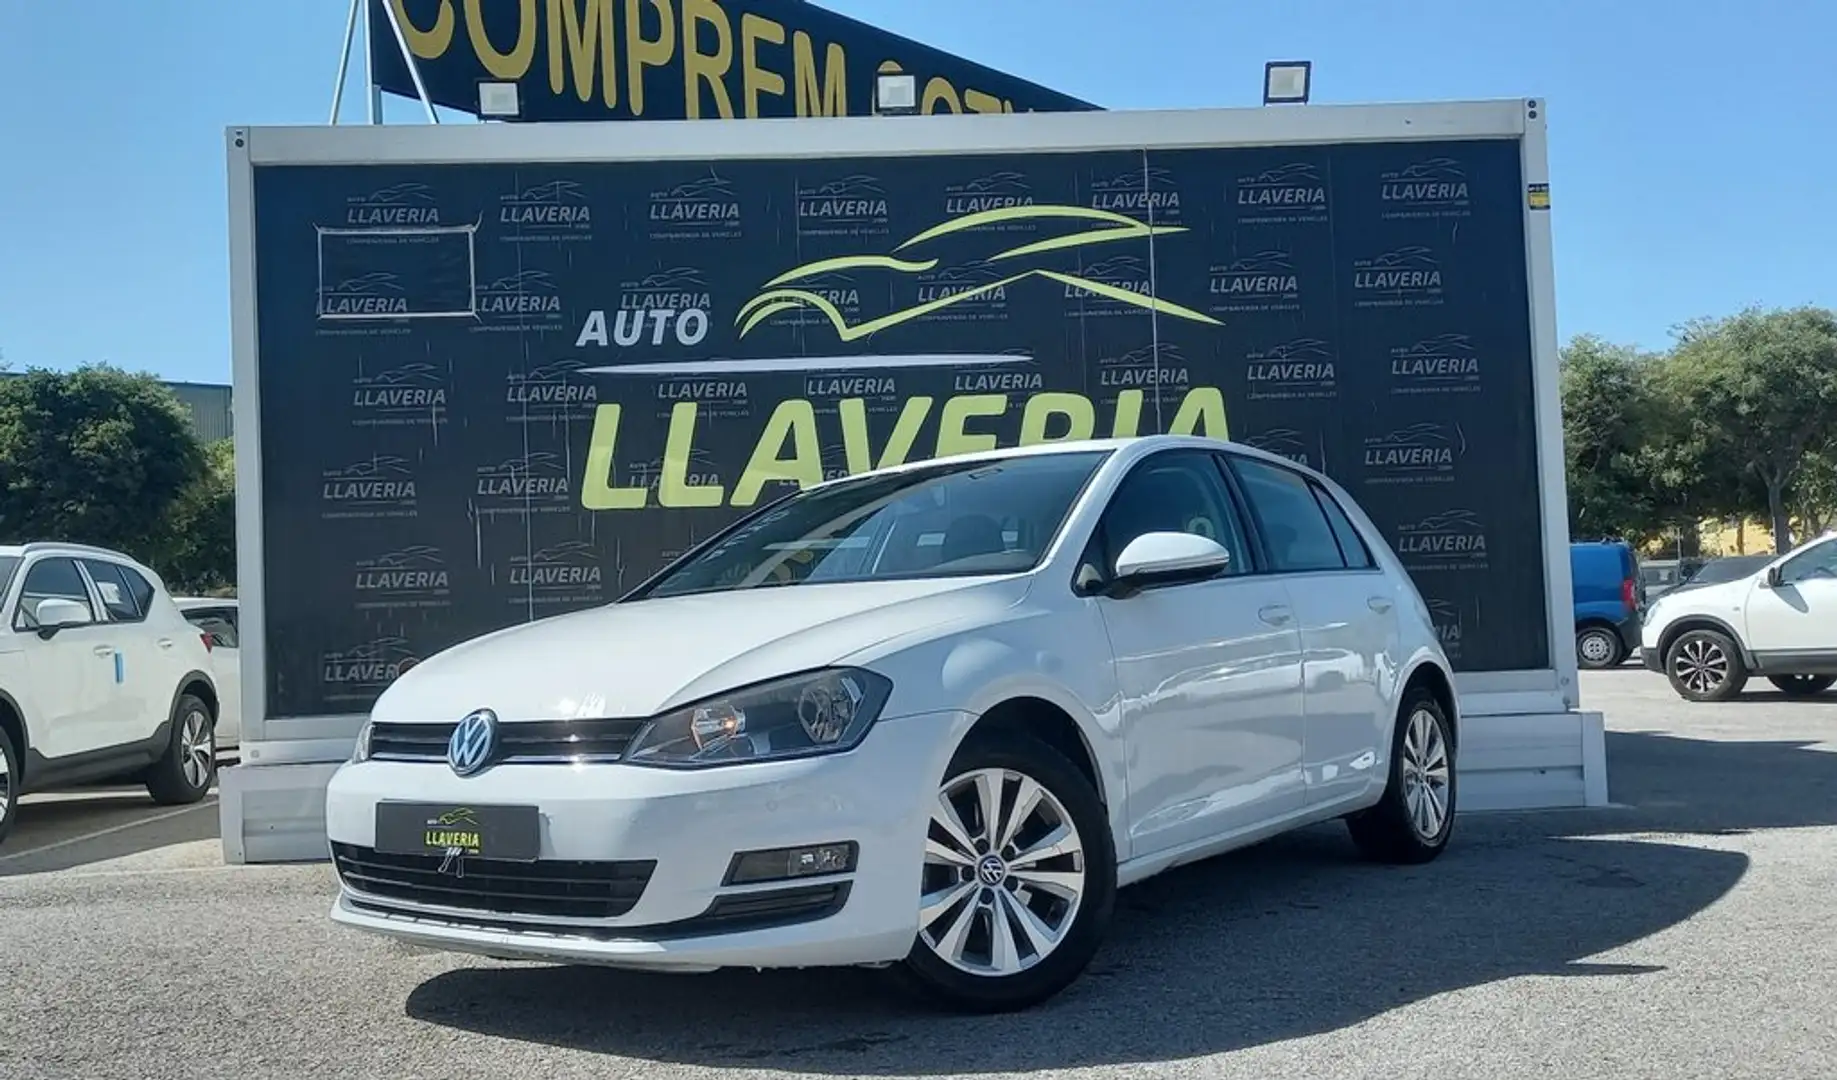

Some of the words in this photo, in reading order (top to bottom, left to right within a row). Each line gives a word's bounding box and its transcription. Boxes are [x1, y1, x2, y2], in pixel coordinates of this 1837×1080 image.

[1237, 188, 1325, 204] LLAVERIA
[1382, 183, 1468, 199] LLAVERIA
[800, 200, 887, 216] LLAVERIA
[1092, 192, 1180, 208] LLAVERIA
[347, 207, 439, 223] LLAVERIA
[501, 206, 591, 222] LLAVERIA
[650, 203, 740, 219] LLAVERIA
[1210, 276, 1298, 293] LLAVERIA
[1354, 271, 1441, 288] LLAVERIA
[1065, 281, 1151, 297] LLRIA
[621, 293, 711, 309] LLAVERIA
[576, 308, 708, 346] AUTO
[1247, 363, 1334, 380] LLAVERIA
[1392, 358, 1478, 375] LLAVERIA
[955, 373, 1043, 390] LLAVERIA
[1101, 368, 1189, 385] LLAVERIA
[507, 385, 597, 402] LLAVERIA
[658, 382, 748, 398] LLAVERIA
[807, 378, 895, 395] LLAVERIA
[354, 388, 445, 405] LLAVERIA
[1365, 448, 1452, 465] LLAVERIA
[323, 482, 416, 498] LLAVERIA
[478, 477, 568, 494] LLAVERIA
[630, 474, 719, 489] LLARIA
[1399, 534, 1486, 552] LLAVERIA
[356, 571, 448, 588] LLAVERIA
[510, 566, 601, 584] LLAVERIA
[425, 831, 479, 847] LLAVERIA
